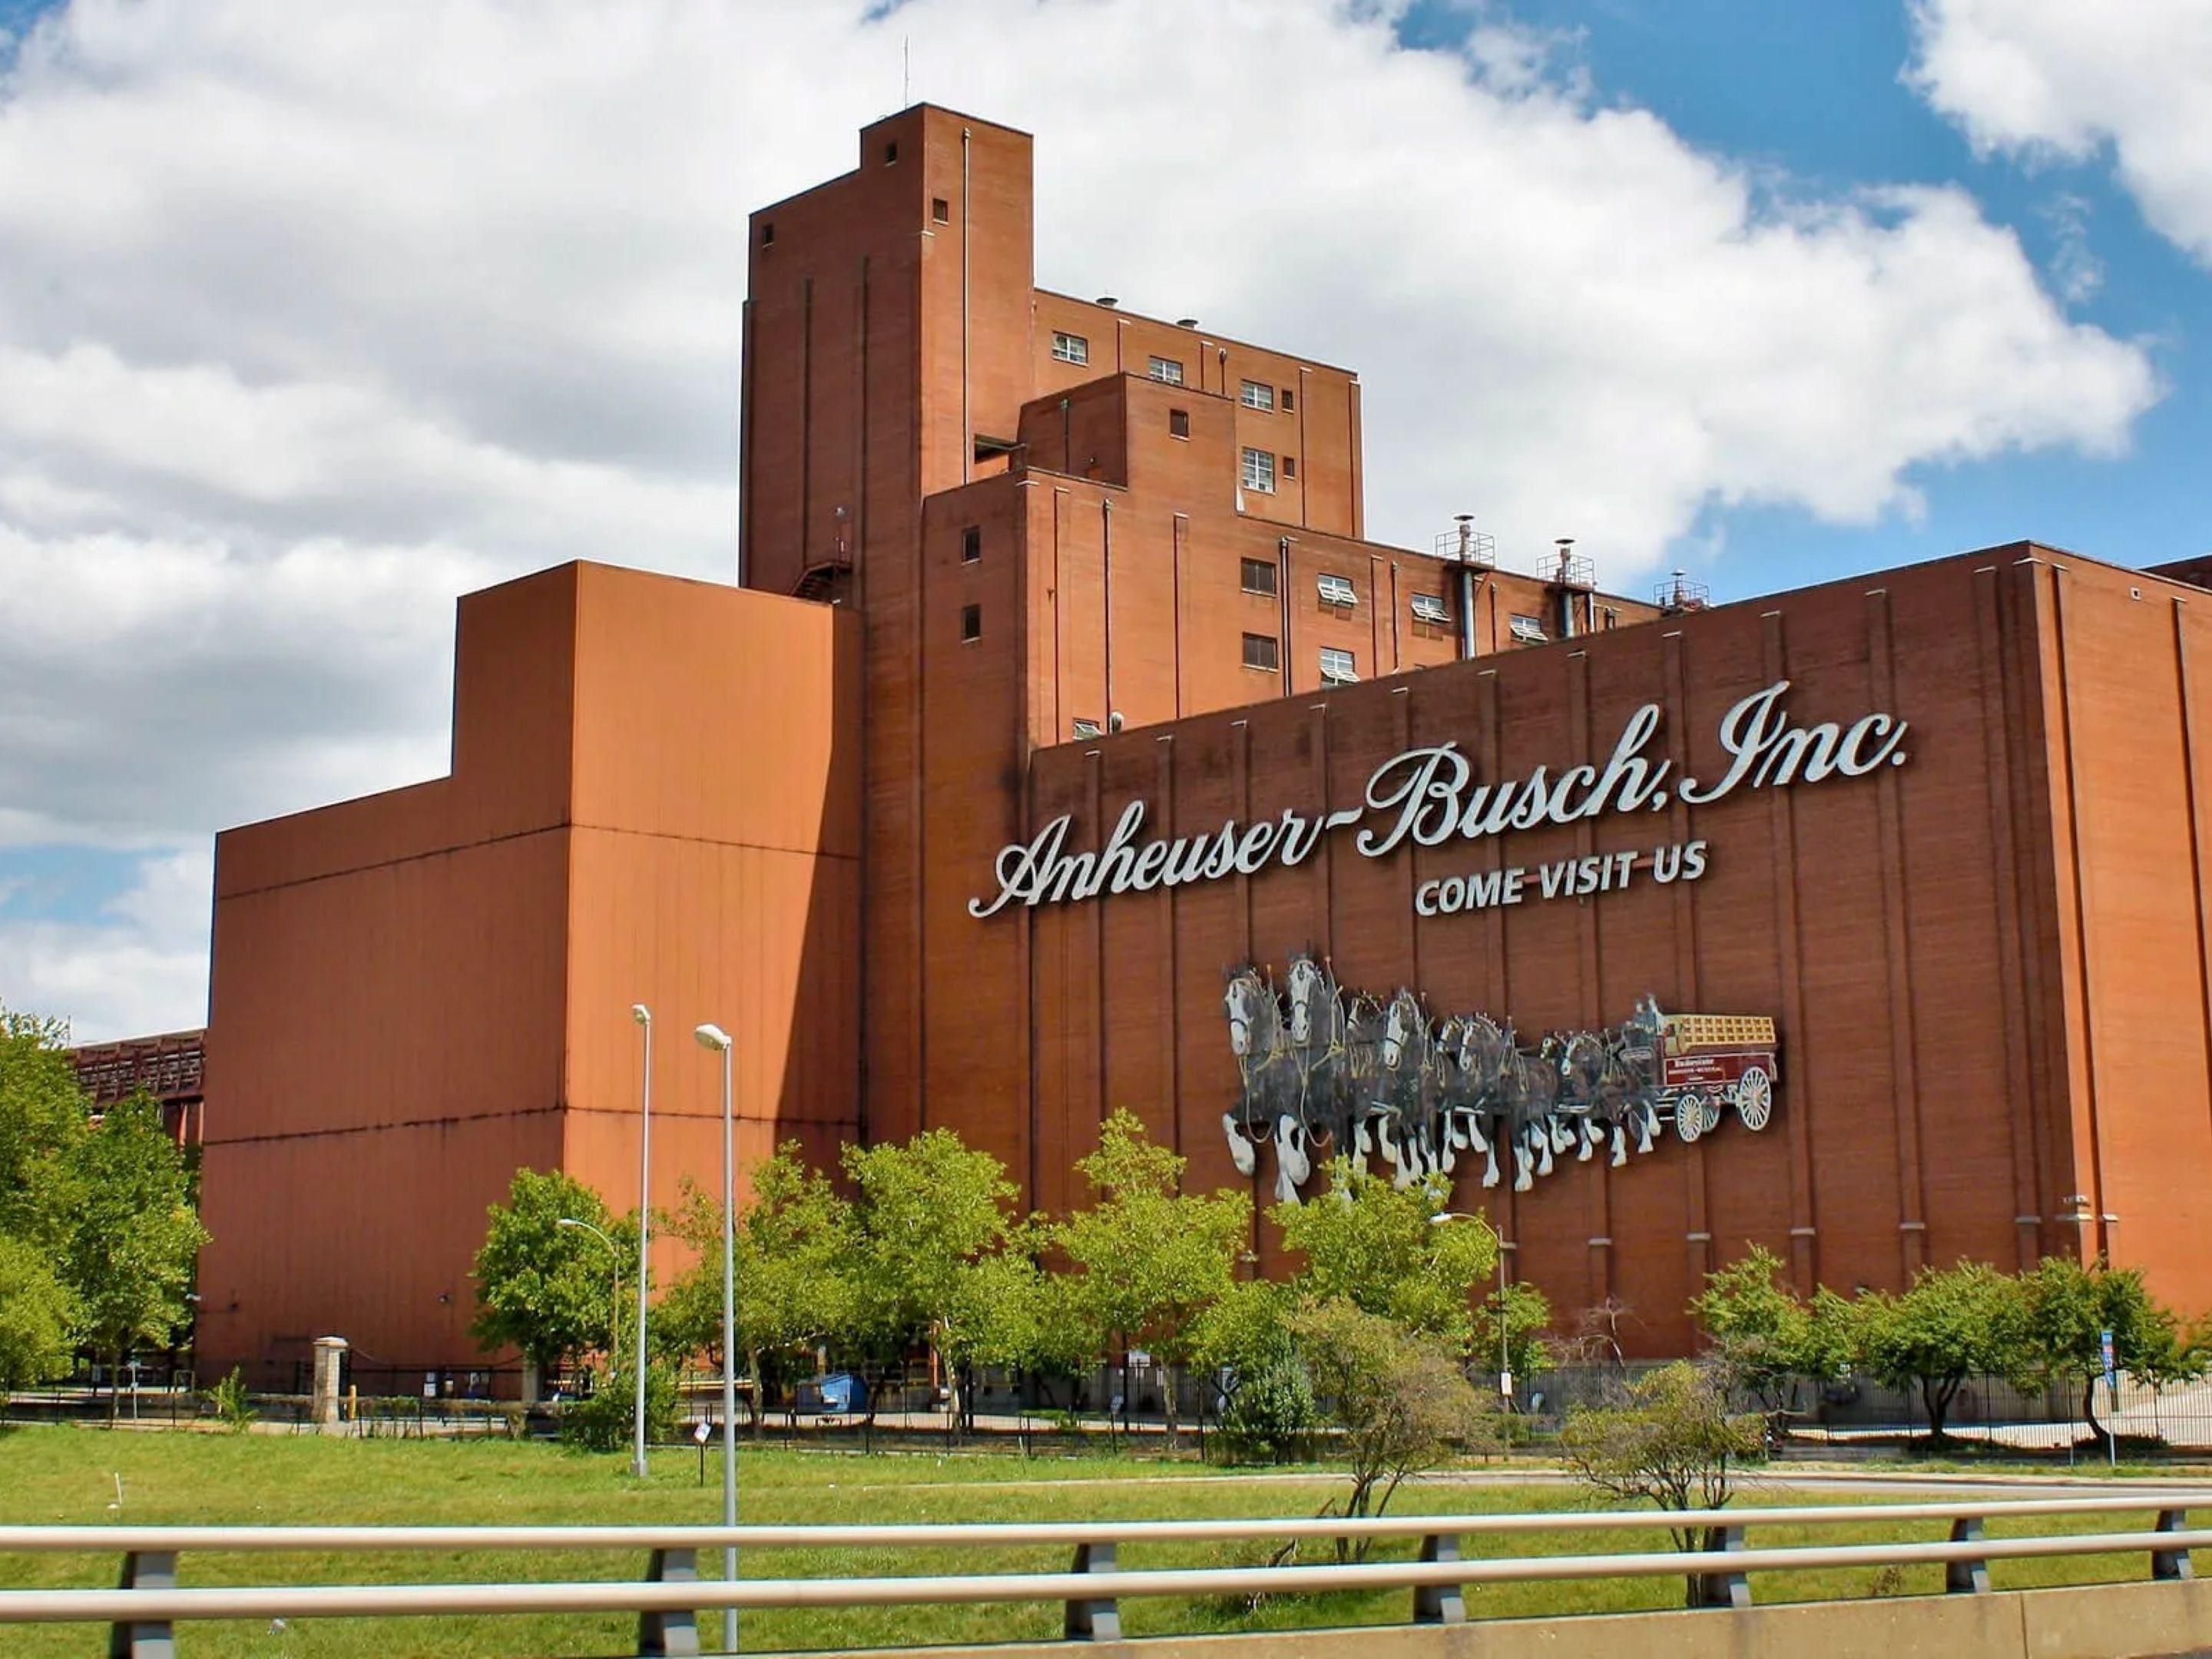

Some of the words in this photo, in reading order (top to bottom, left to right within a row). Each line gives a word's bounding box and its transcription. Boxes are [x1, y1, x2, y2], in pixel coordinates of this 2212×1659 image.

[1678, 680, 1908, 803] Inc.
[1415, 867, 1525, 916] COME
[1538, 850, 1639, 899] VISIT
[1653, 839, 1708, 883] US
